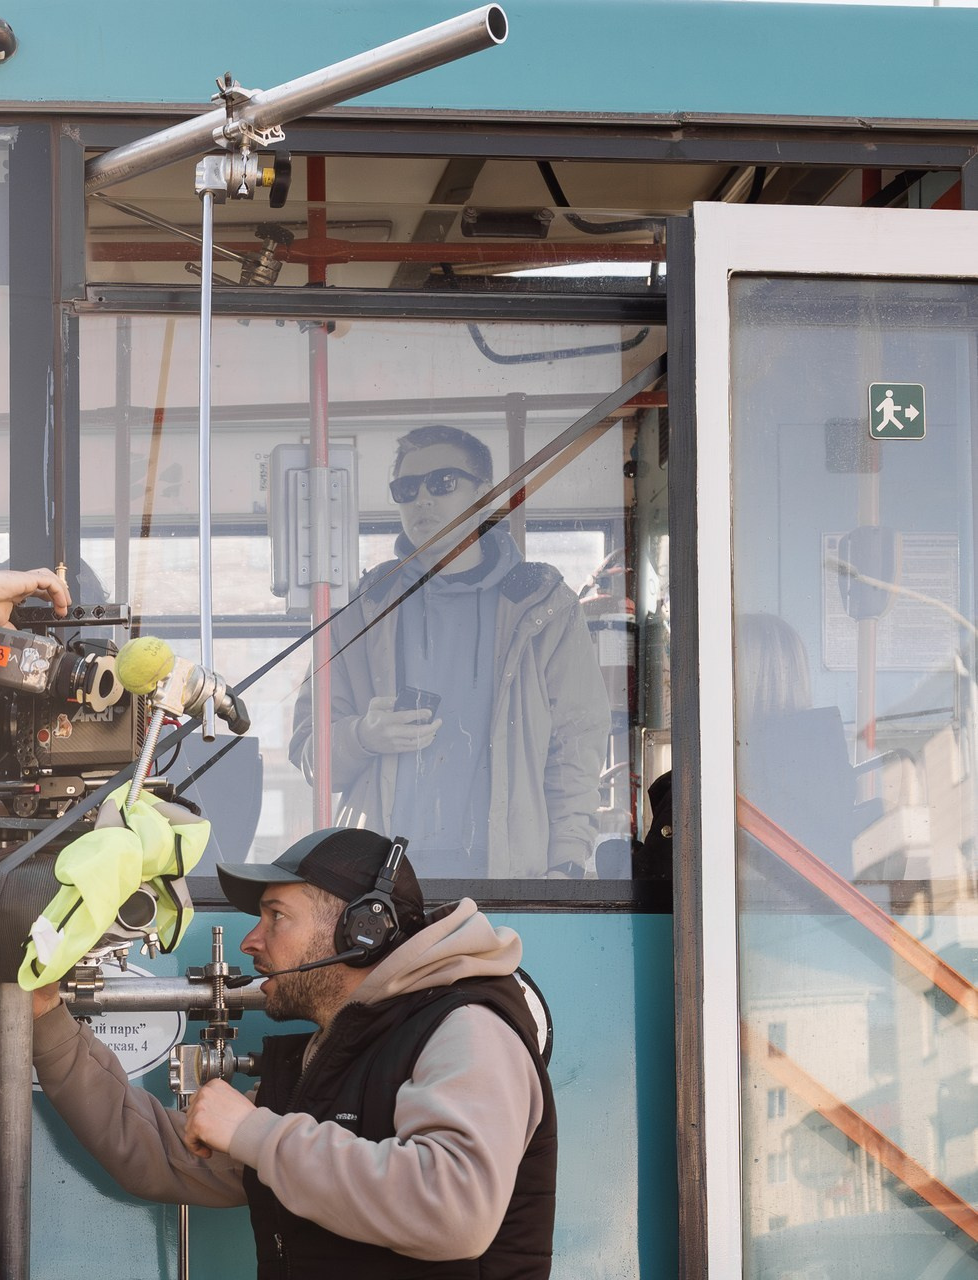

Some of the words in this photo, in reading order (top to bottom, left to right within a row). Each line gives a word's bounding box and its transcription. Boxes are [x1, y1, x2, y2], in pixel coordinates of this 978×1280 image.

[71, 706, 114, 722] ARRI
[104, 1042, 138, 1053] ская,
[141, 1040, 148, 1052] 4
